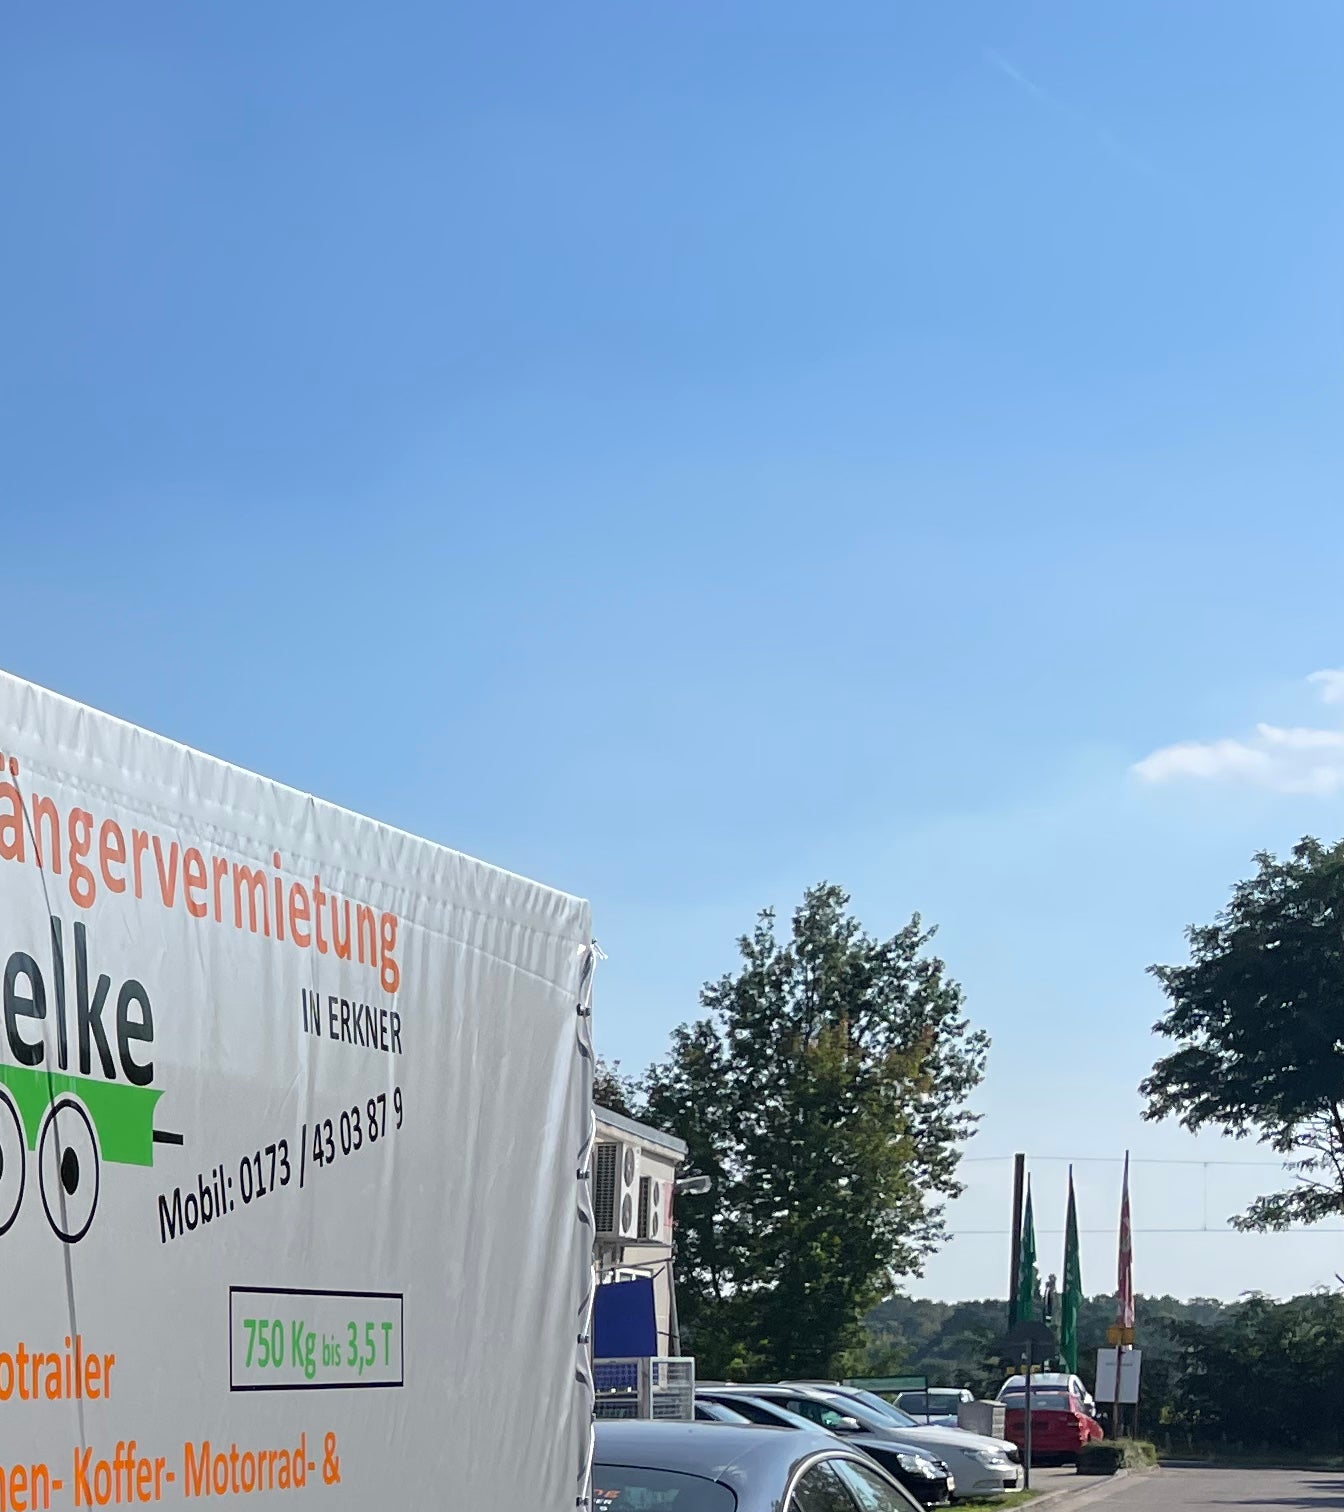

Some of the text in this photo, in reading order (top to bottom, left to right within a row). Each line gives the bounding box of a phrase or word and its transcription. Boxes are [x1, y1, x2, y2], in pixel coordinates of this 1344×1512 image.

[301, 987, 403, 1056] IN ERKNER
[158, 1165, 235, 1244] Mobil:
[239, 1139, 291, 1204] 0173
[312, 1118, 335, 1168] 43
[339, 1106, 363, 1159] 03
[367, 1093, 389, 1142] 87
[392, 1085, 404, 1131] 9
[242, 1318, 393, 1379] 750 Kg bis 3,5 T
[73, 1439, 175, 1508] Koffer-
[183, 1431, 316, 1499] Motorrad-
[322, 1430, 342, 1485] &
